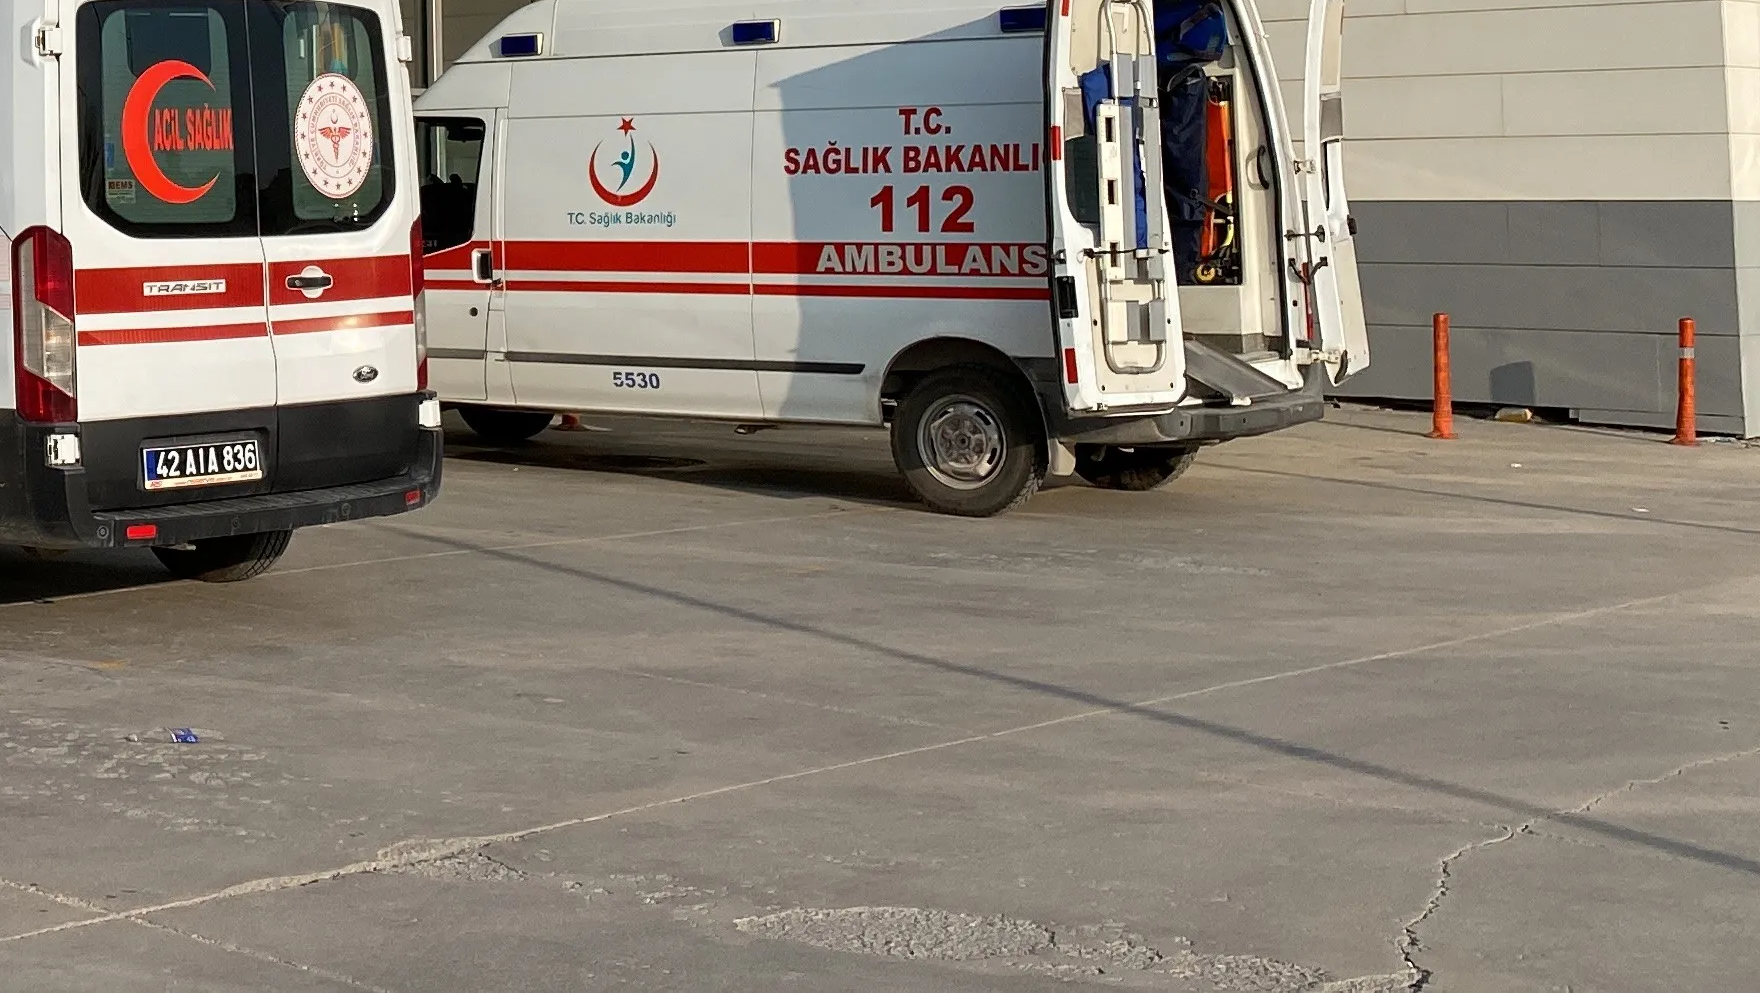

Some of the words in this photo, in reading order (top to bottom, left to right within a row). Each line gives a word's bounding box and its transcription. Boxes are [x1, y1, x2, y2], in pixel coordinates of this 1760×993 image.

[898, 107, 952, 136] T.C.
[783, 140, 893, 175] SAĞLIK
[903, 143, 1041, 174] BAKANLI
[588, 211, 623, 228] Sağlık
[625, 211, 677, 228] Bakanlığı
[870, 185, 975, 234] 112
[815, 244, 1048, 275] AMBULANS
[145, 281, 224, 294] TRANSIT
[612, 371, 661, 390] 5530
[155, 450, 181, 478] 42
[185, 446, 219, 476] AIA
[222, 443, 256, 472] 836
